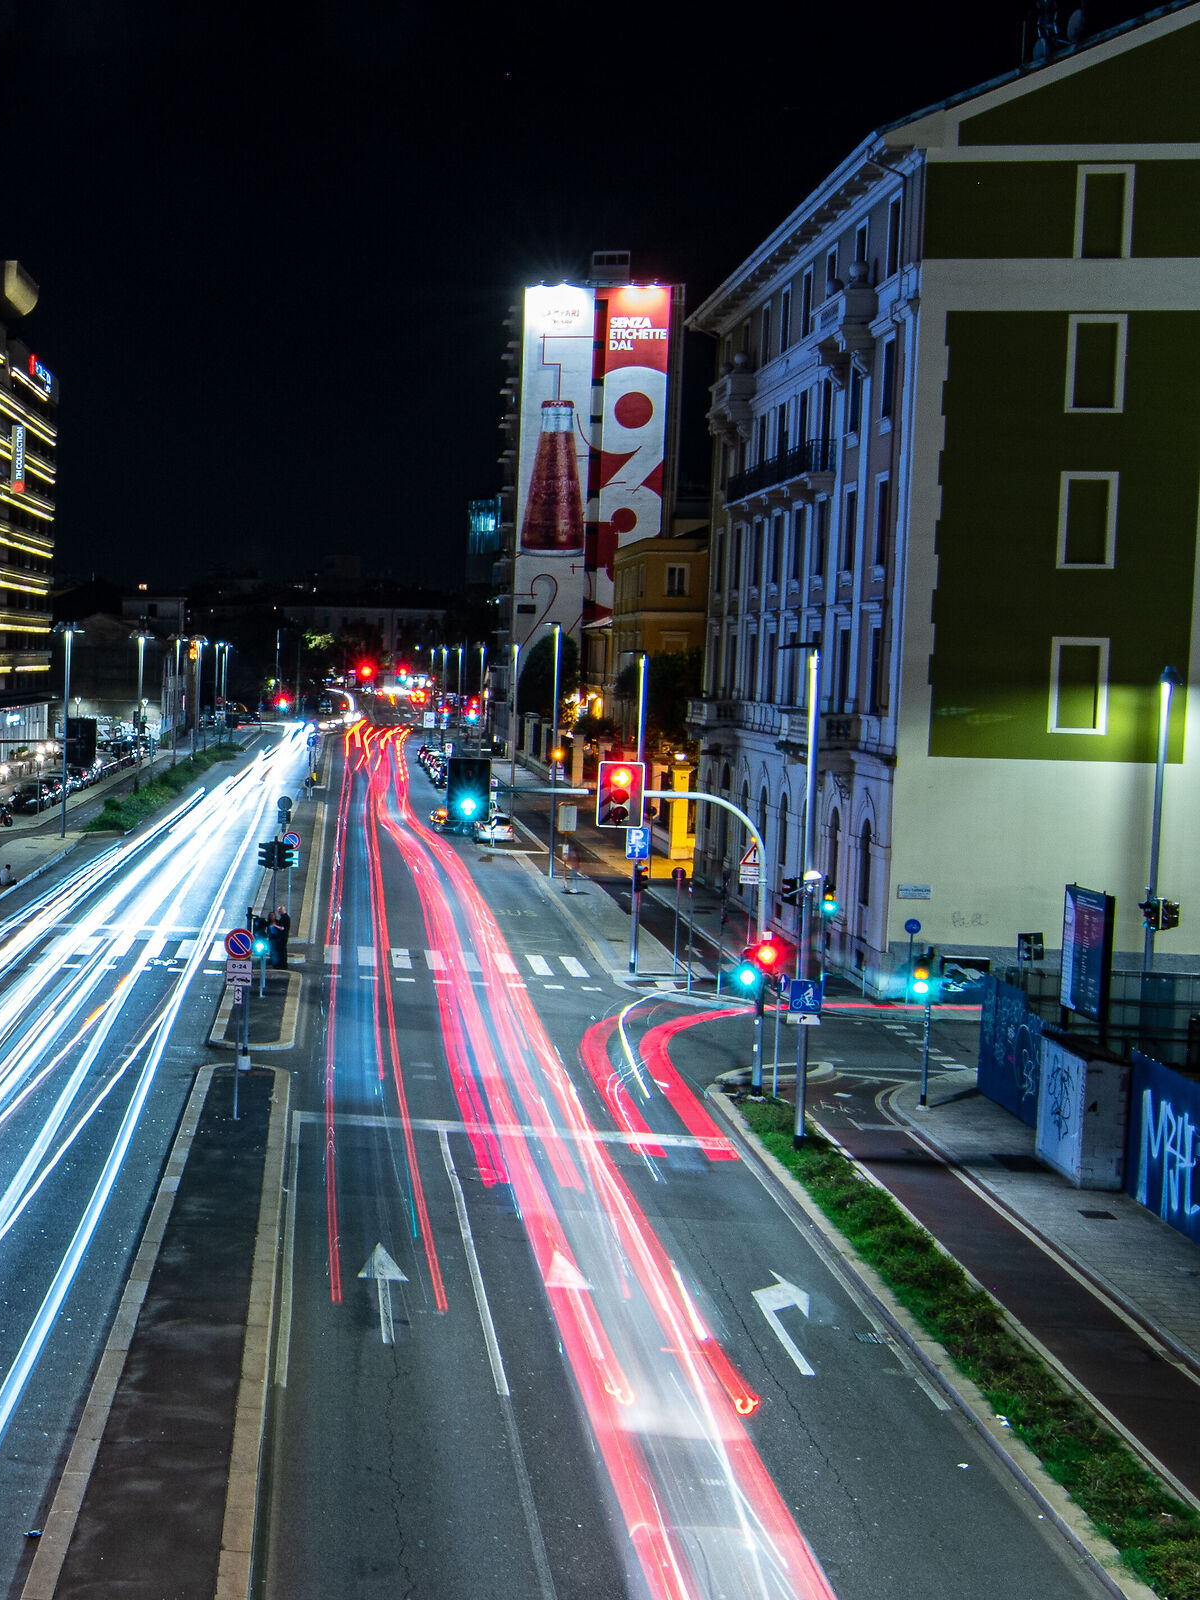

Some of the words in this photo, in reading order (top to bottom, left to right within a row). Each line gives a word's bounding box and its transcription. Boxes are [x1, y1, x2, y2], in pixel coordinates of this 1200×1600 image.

[609, 316, 652, 329] SENZA
[609, 328, 668, 340] ETICHETTE
[609, 340, 634, 351] DAL
[16, 426, 24, 470] COLLECTION
[631, 829, 644, 844] P
